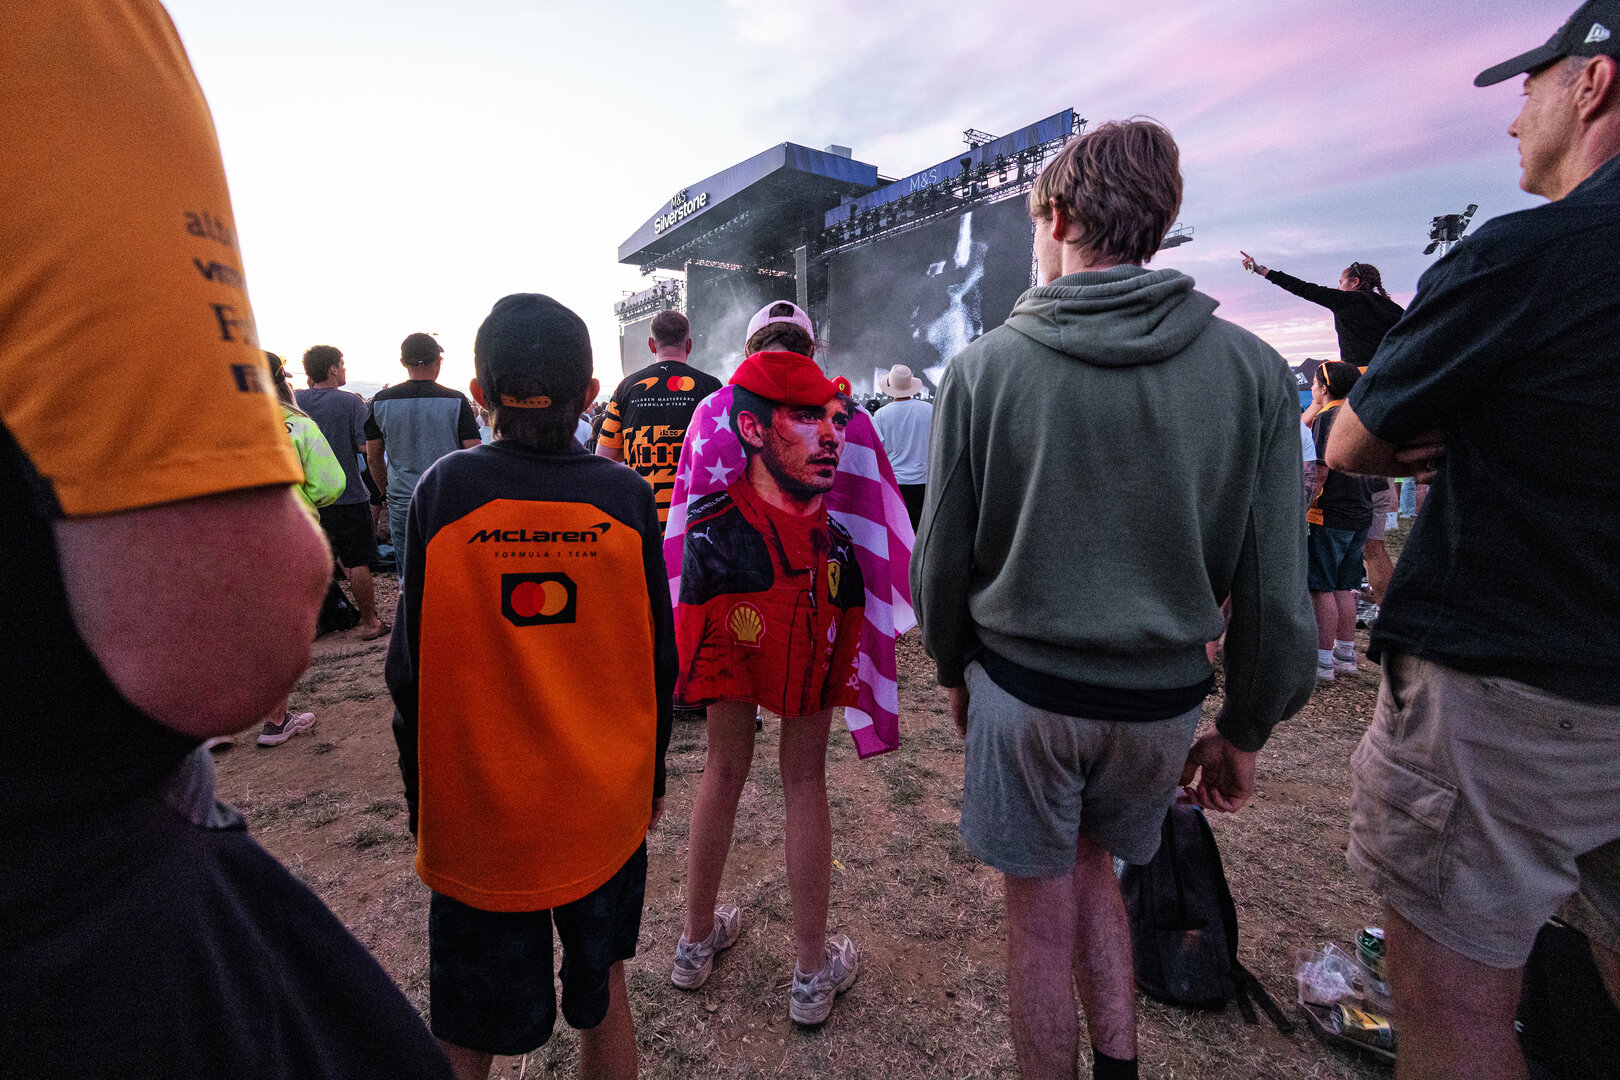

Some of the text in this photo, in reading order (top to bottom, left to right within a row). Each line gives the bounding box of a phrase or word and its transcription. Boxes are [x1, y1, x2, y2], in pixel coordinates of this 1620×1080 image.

[910, 168, 937, 192] M&S
[671, 189, 686, 210] M&S
[654, 192, 707, 235] Silverstone
